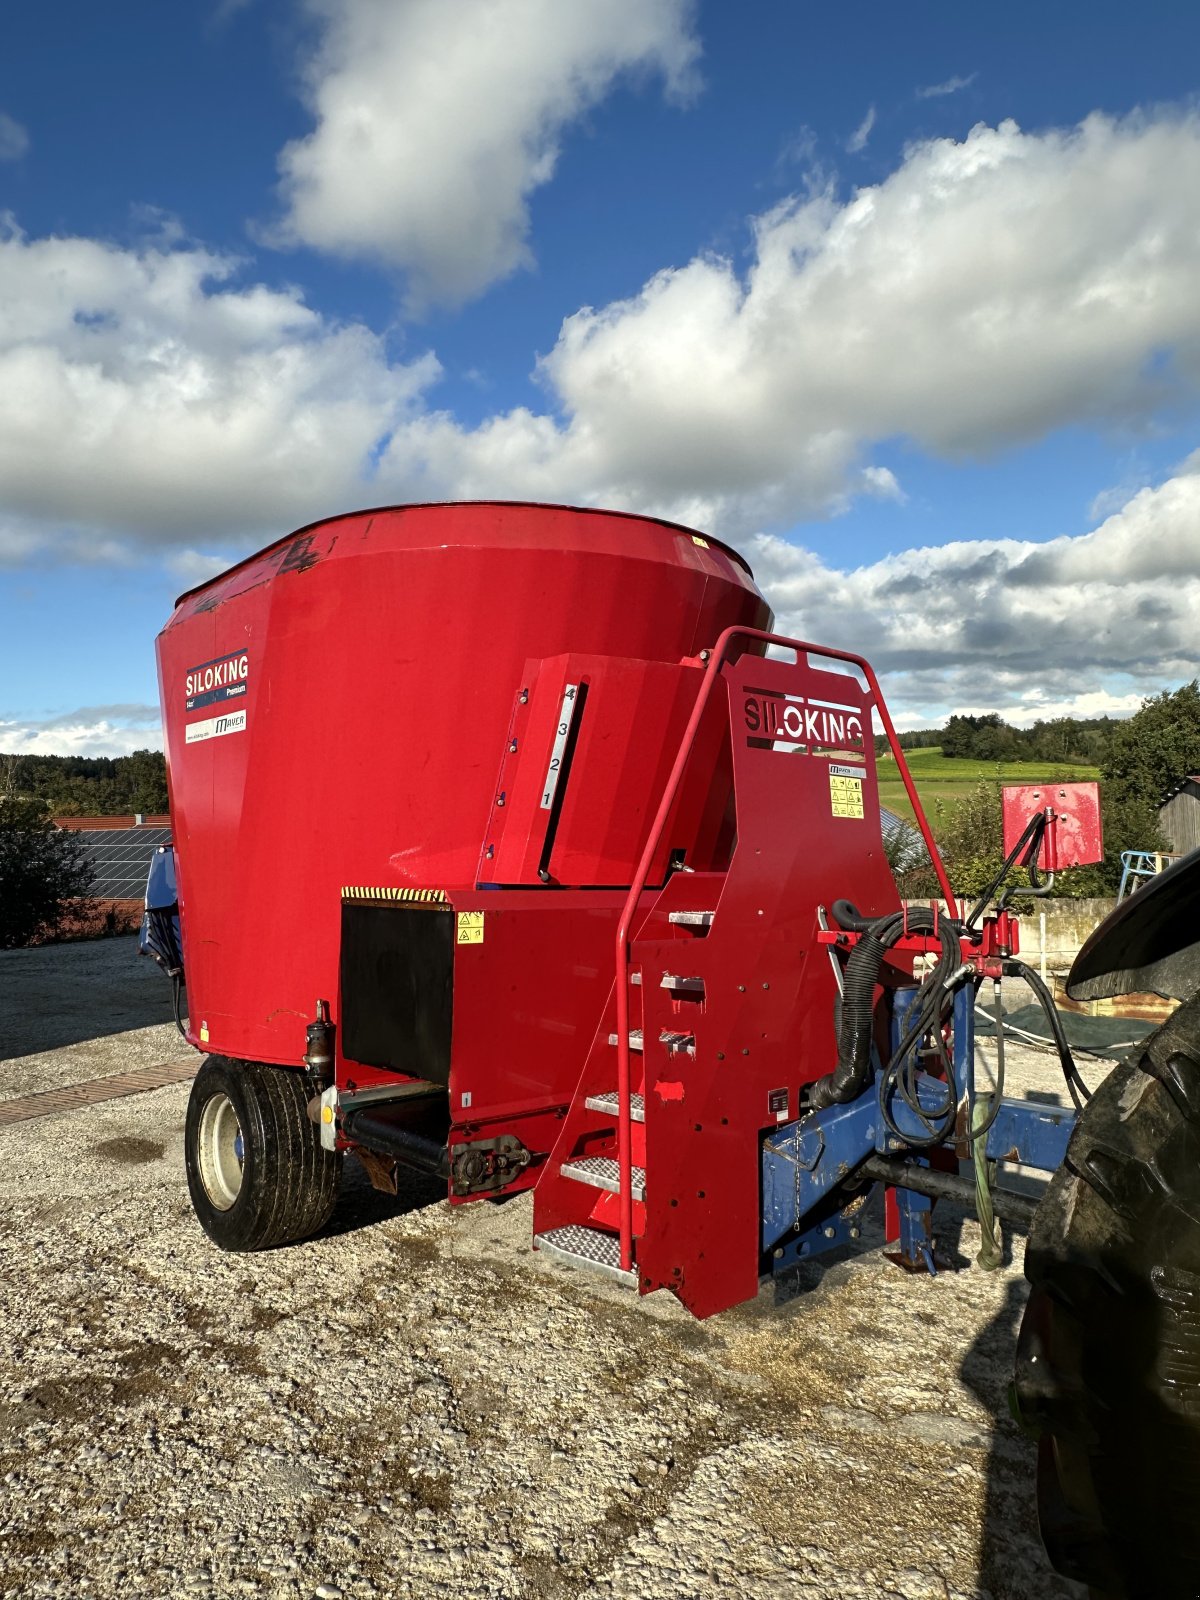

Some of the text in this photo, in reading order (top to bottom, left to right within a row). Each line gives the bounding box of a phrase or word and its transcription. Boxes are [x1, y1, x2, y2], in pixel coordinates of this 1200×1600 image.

[186, 656, 248, 696] SILOKING
[565, 688, 575, 700] 4
[744, 698, 864, 745] SILOKING
[558, 723, 568, 735] 3
[550, 758, 560, 771] 2
[543, 793, 550, 805] 1
